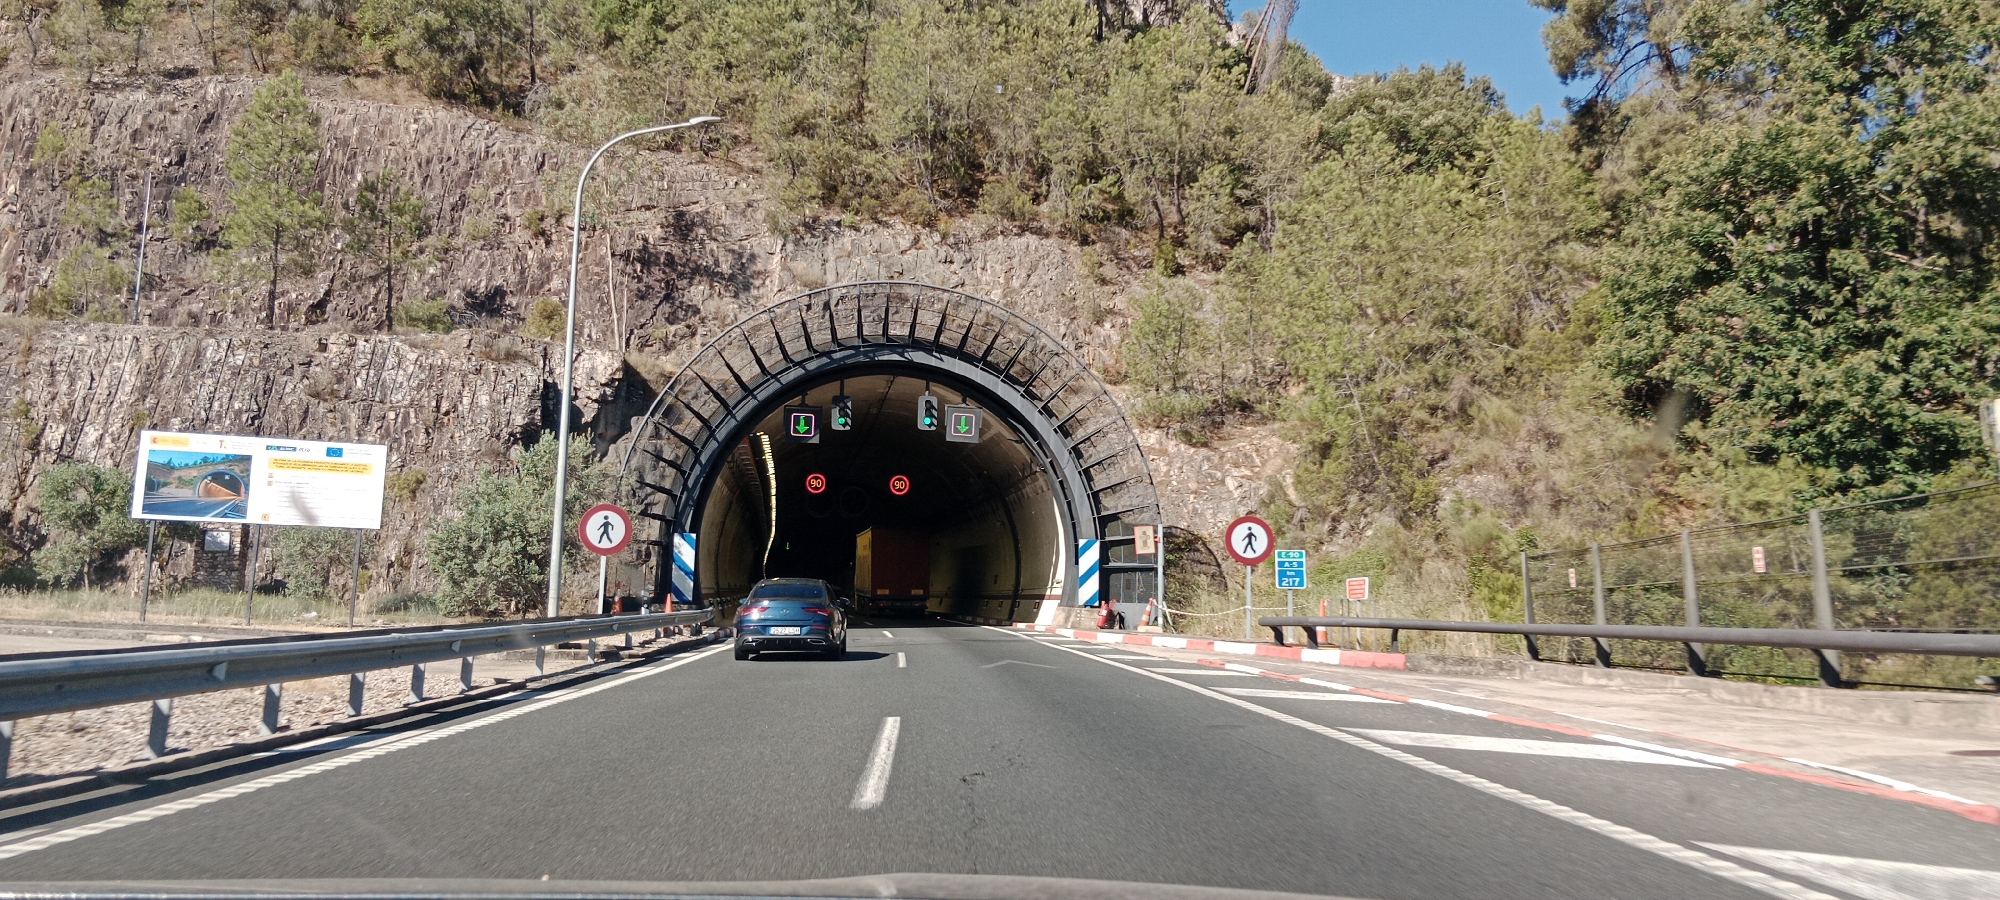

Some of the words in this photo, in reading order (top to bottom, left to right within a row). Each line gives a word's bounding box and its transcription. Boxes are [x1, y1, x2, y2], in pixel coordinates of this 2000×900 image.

[810, 478, 822, 488] 90
[894, 480, 906, 490] 90
[1282, 578, 1300, 586] 217
